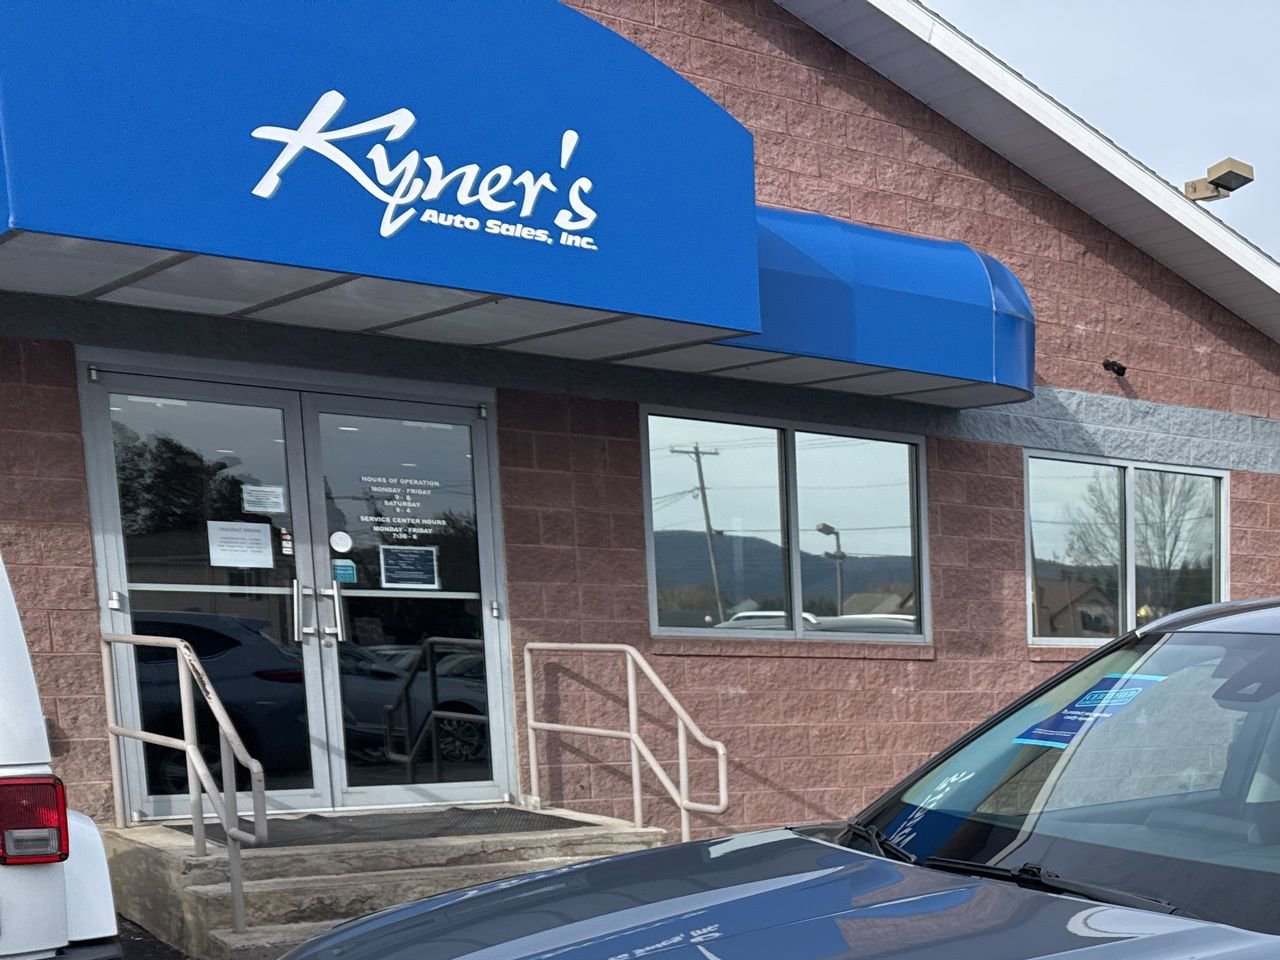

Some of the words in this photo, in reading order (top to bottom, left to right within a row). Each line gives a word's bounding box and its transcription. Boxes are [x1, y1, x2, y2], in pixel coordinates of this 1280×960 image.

[251, 89, 598, 238] Kyner's
[420, 208, 480, 230] Auto
[485, 219, 553, 245] Sales,
[559, 231, 598, 250] Inc.
[360, 515, 391, 523] SERVICE
[421, 518, 446, 526] HOURS
